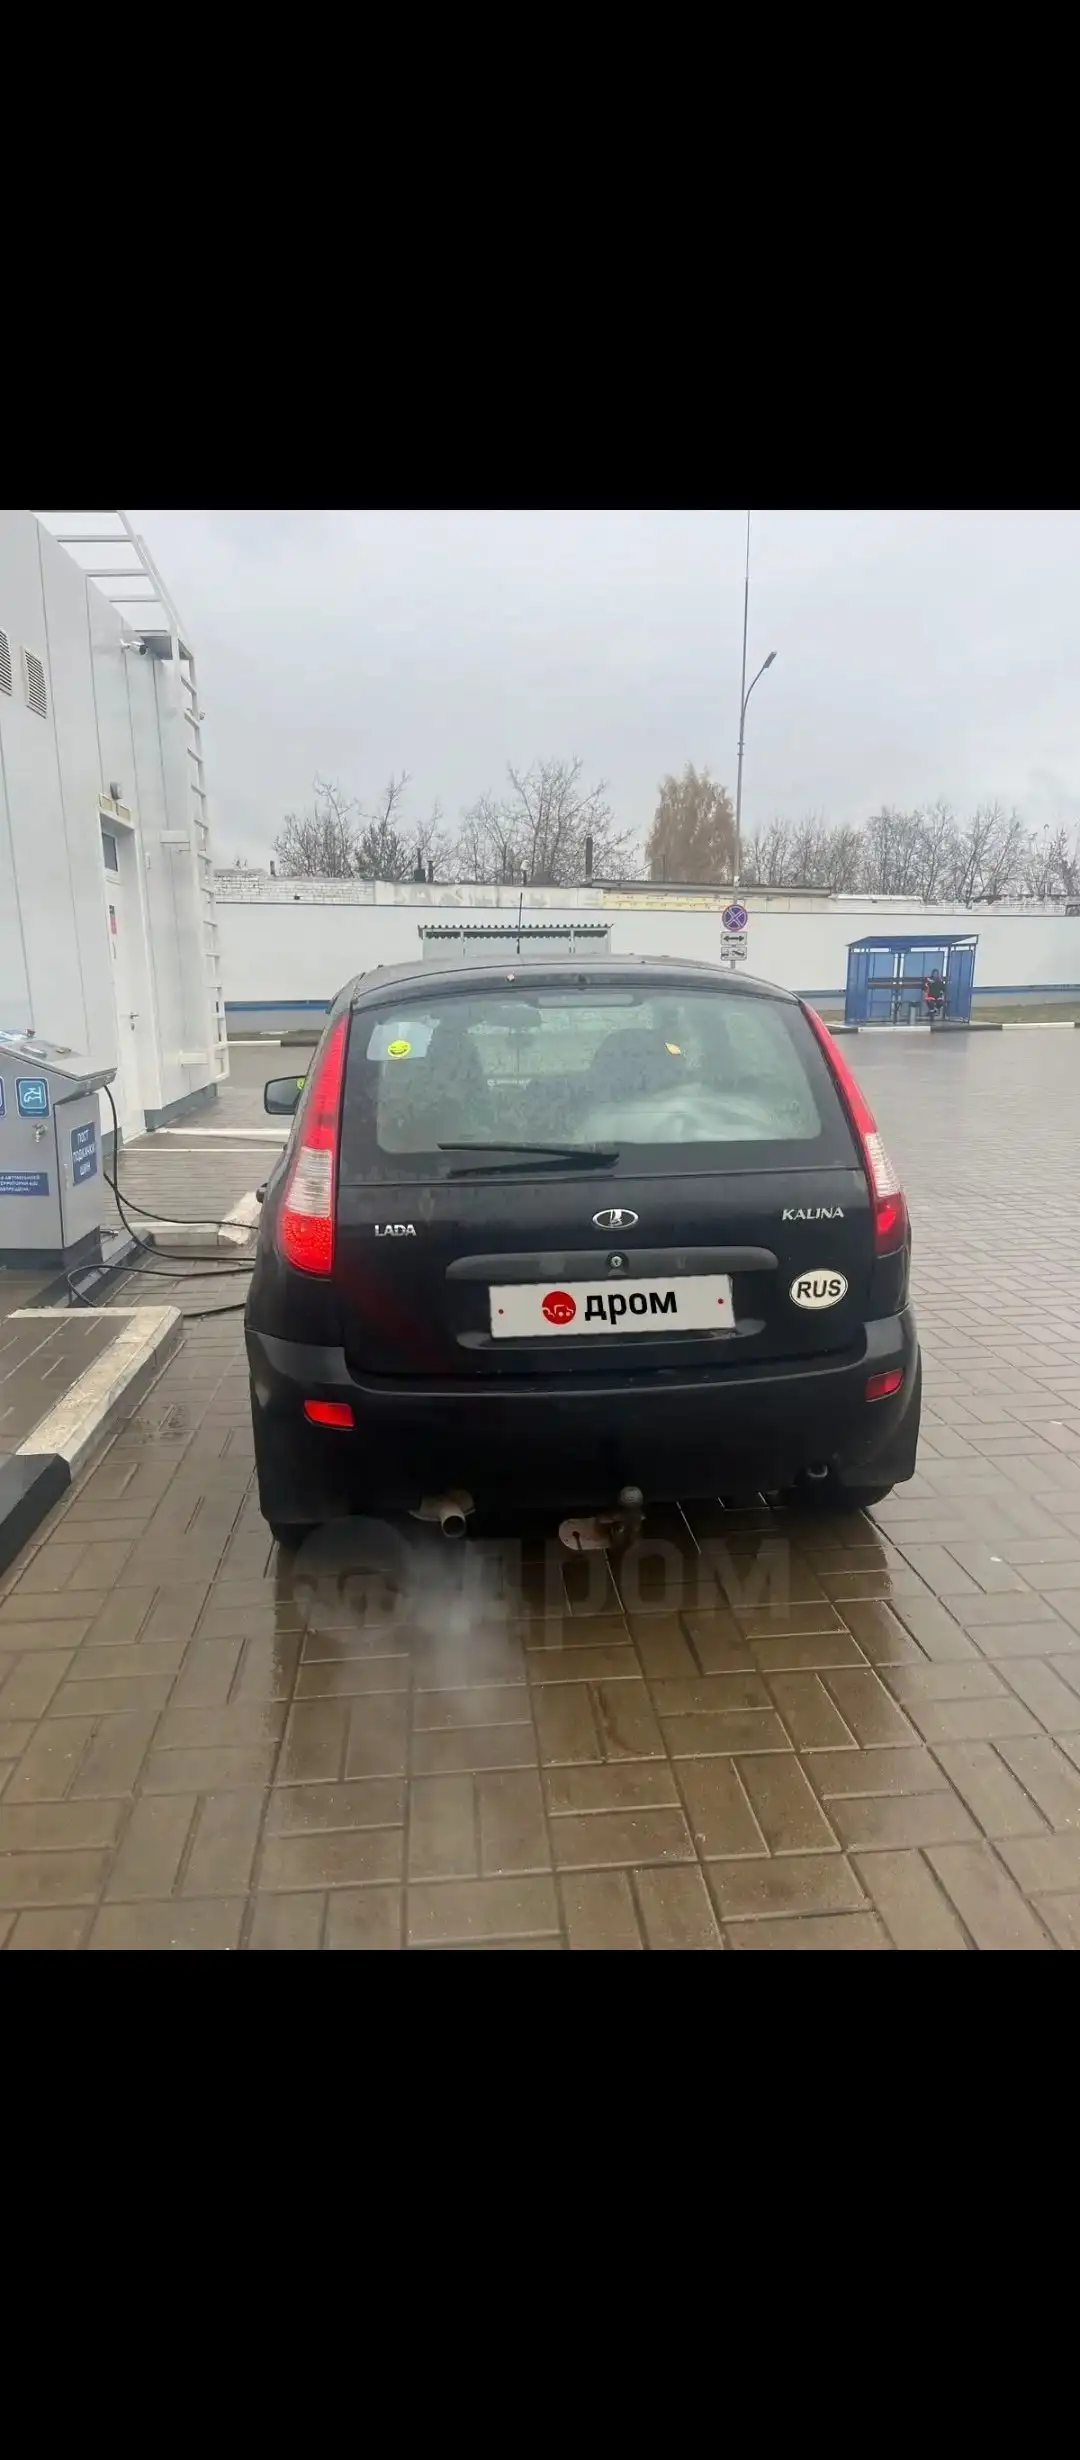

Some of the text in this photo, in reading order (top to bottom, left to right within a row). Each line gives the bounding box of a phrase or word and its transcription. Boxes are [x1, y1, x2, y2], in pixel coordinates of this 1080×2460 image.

[782, 1207, 845, 1221] KALINA
[374, 1224, 417, 1237] LADA
[797, 1279, 842, 1299] RUS
